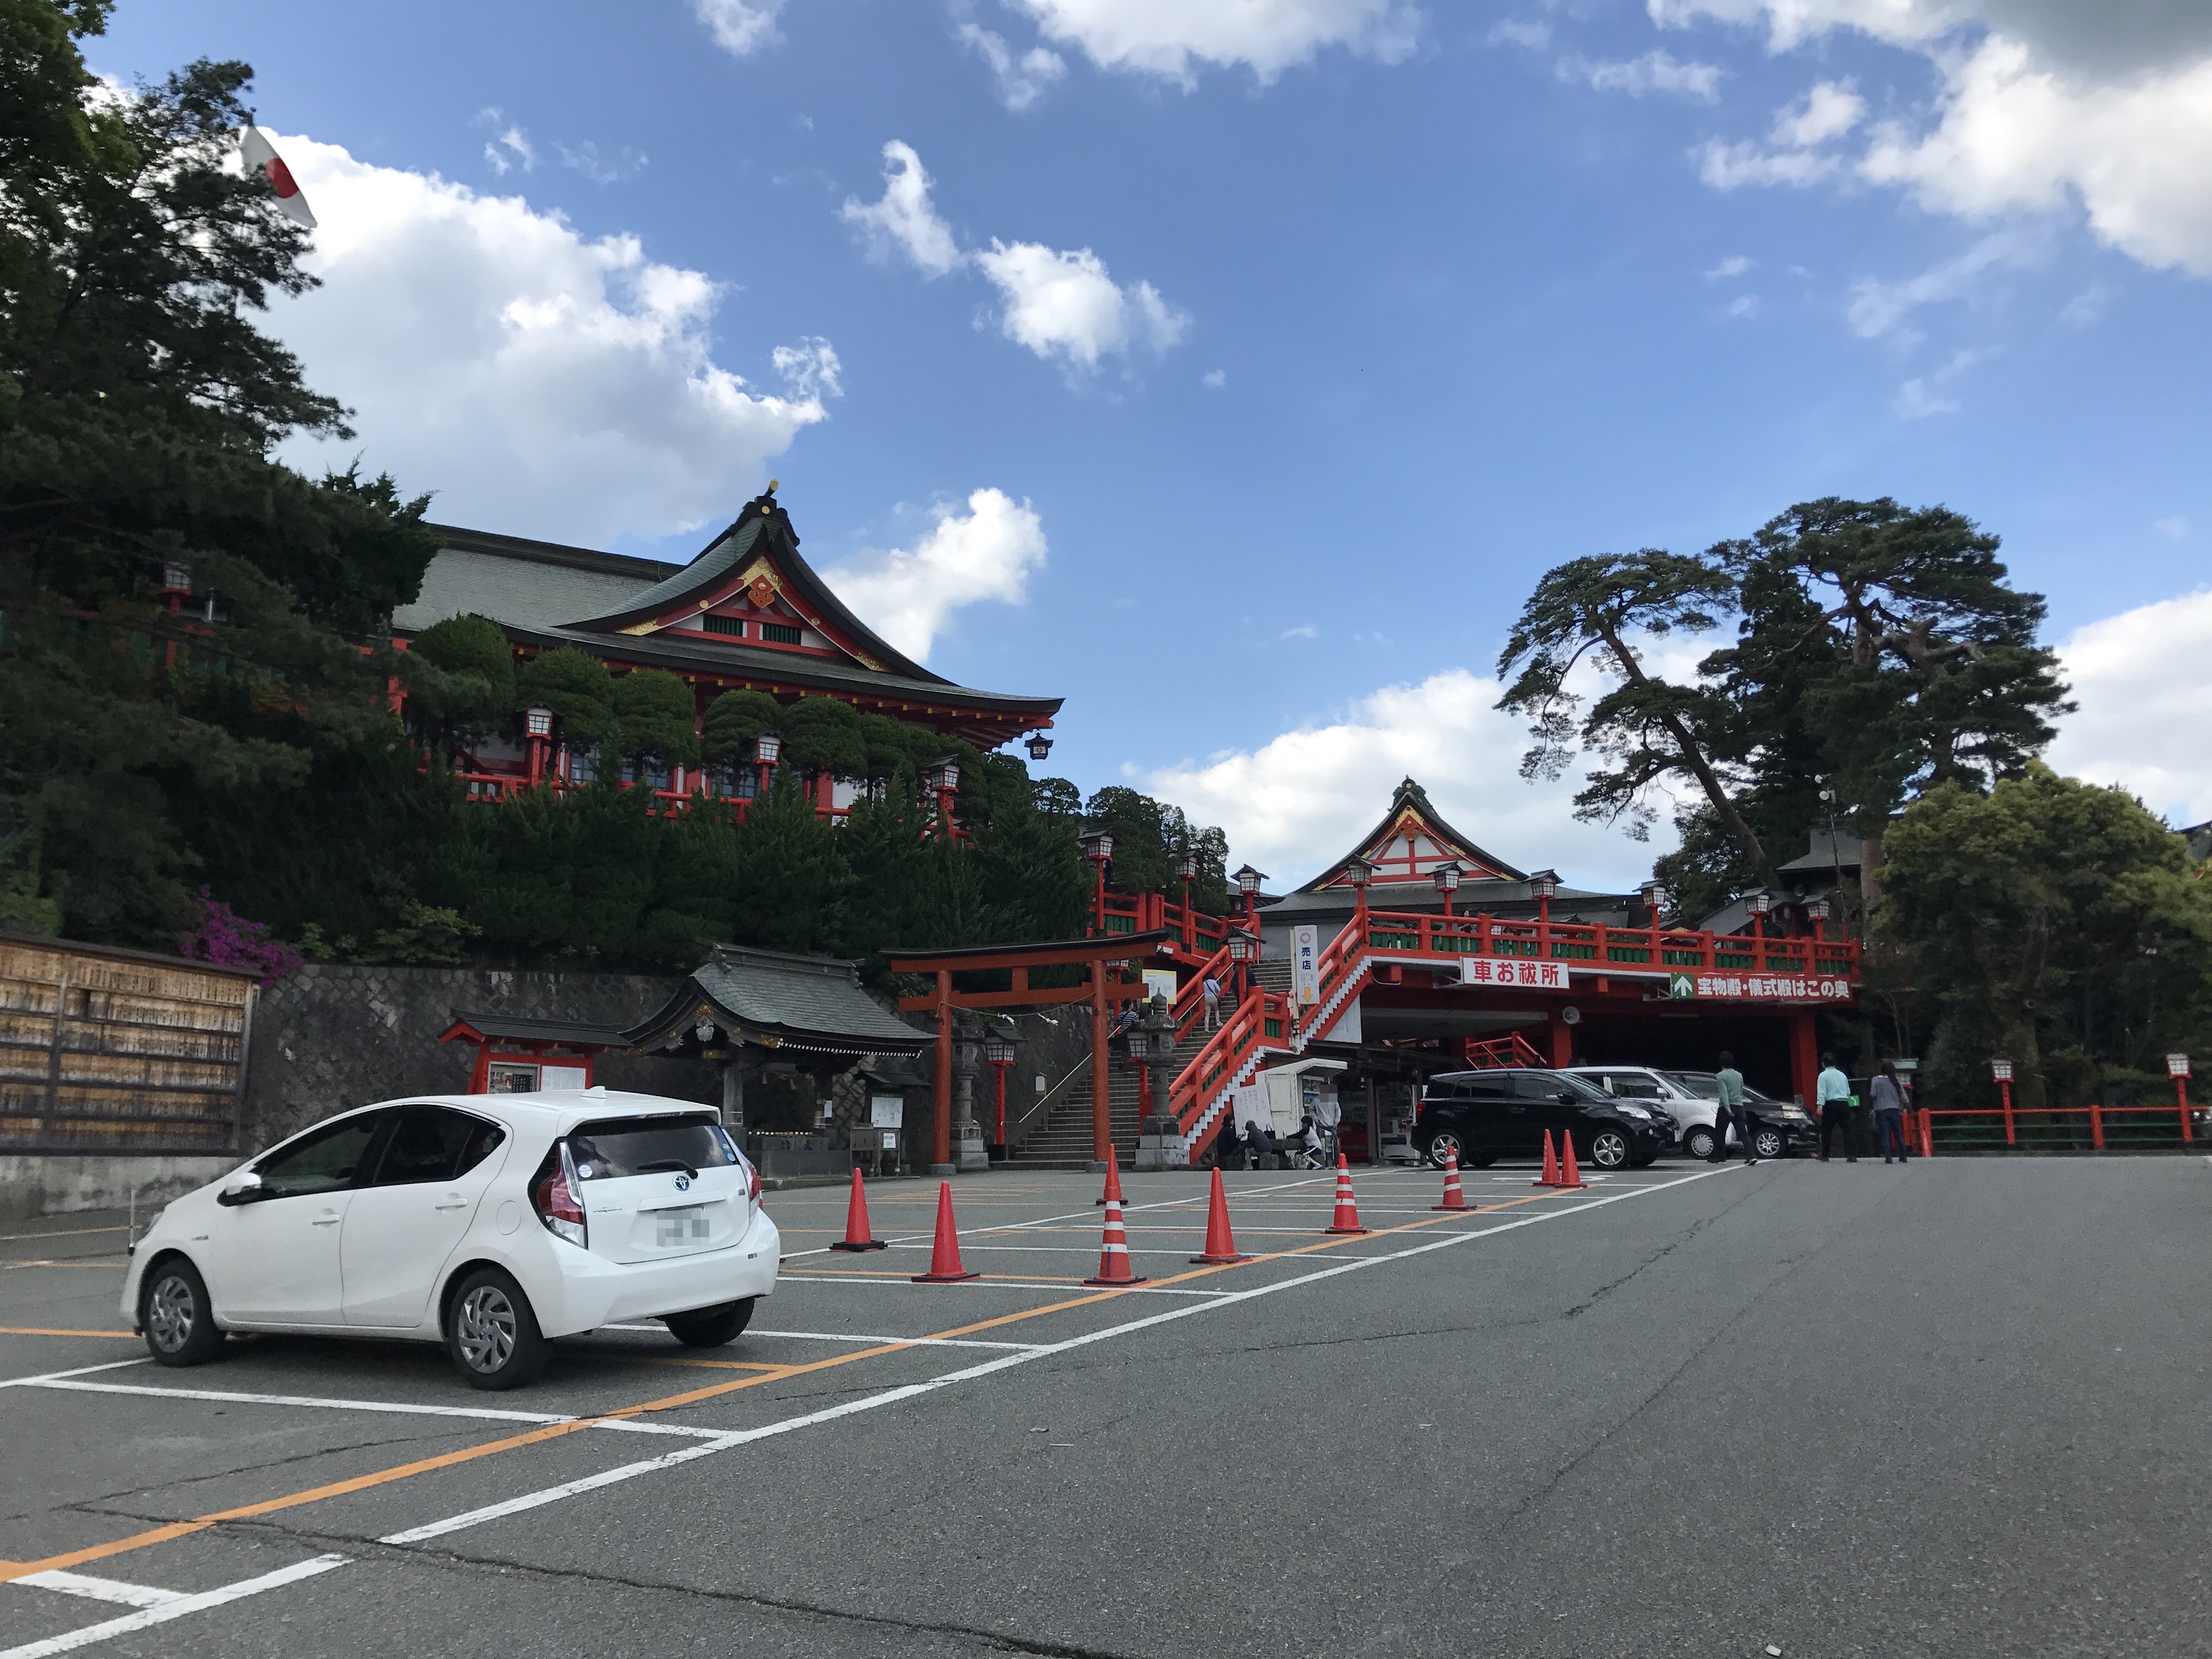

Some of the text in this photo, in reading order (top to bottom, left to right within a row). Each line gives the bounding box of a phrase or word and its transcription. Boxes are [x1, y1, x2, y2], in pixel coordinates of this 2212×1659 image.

[1301, 947, 1311, 970] 売店
[1474, 960, 1559, 986] 車お祓所
[1697, 977, 1849, 998] 宝物殿・儀式殿はこの奥
